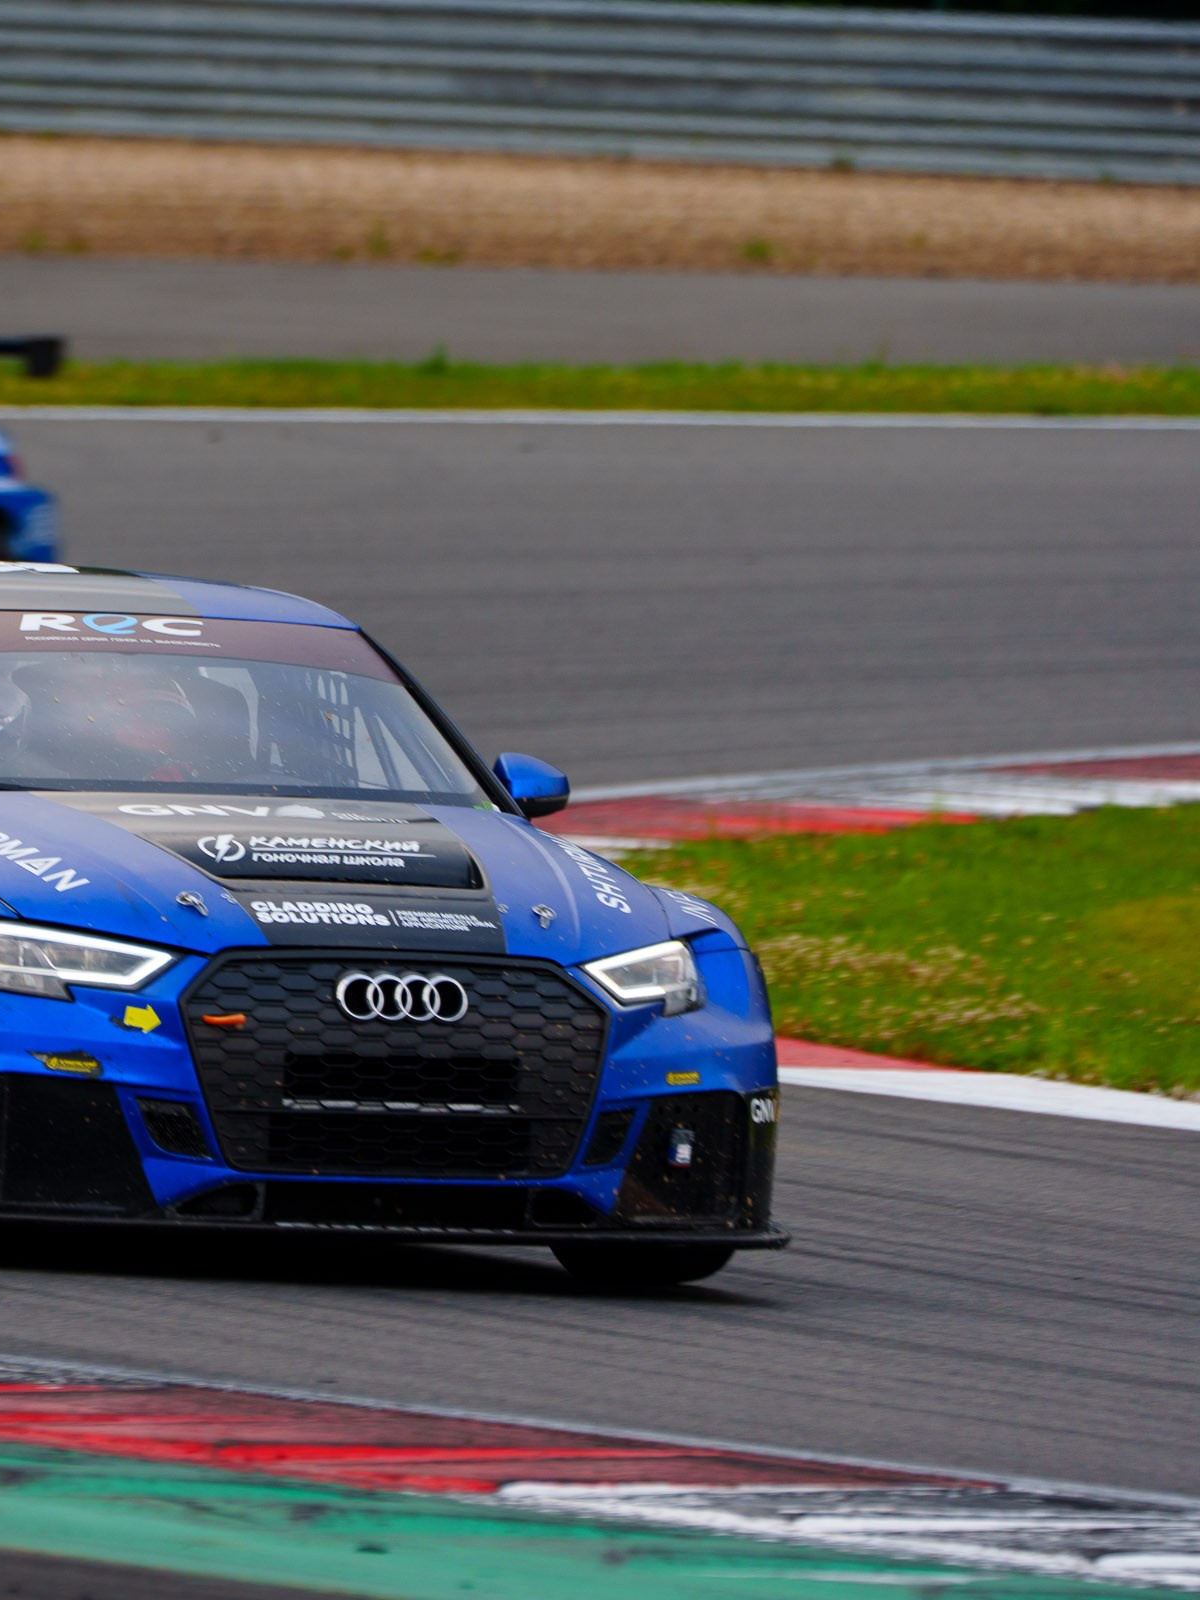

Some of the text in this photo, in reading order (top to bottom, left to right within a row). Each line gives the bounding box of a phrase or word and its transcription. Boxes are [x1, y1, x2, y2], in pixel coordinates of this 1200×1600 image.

[118, 804, 270, 817] GNV
[249, 835, 421, 853] КАМЕНСКИЙ
[252, 852, 406, 868] ГОНОЧНАЯ ШКОЛА
[250, 901, 375, 915] CLADDING
[255, 912, 392, 927] SOLUTIONS
